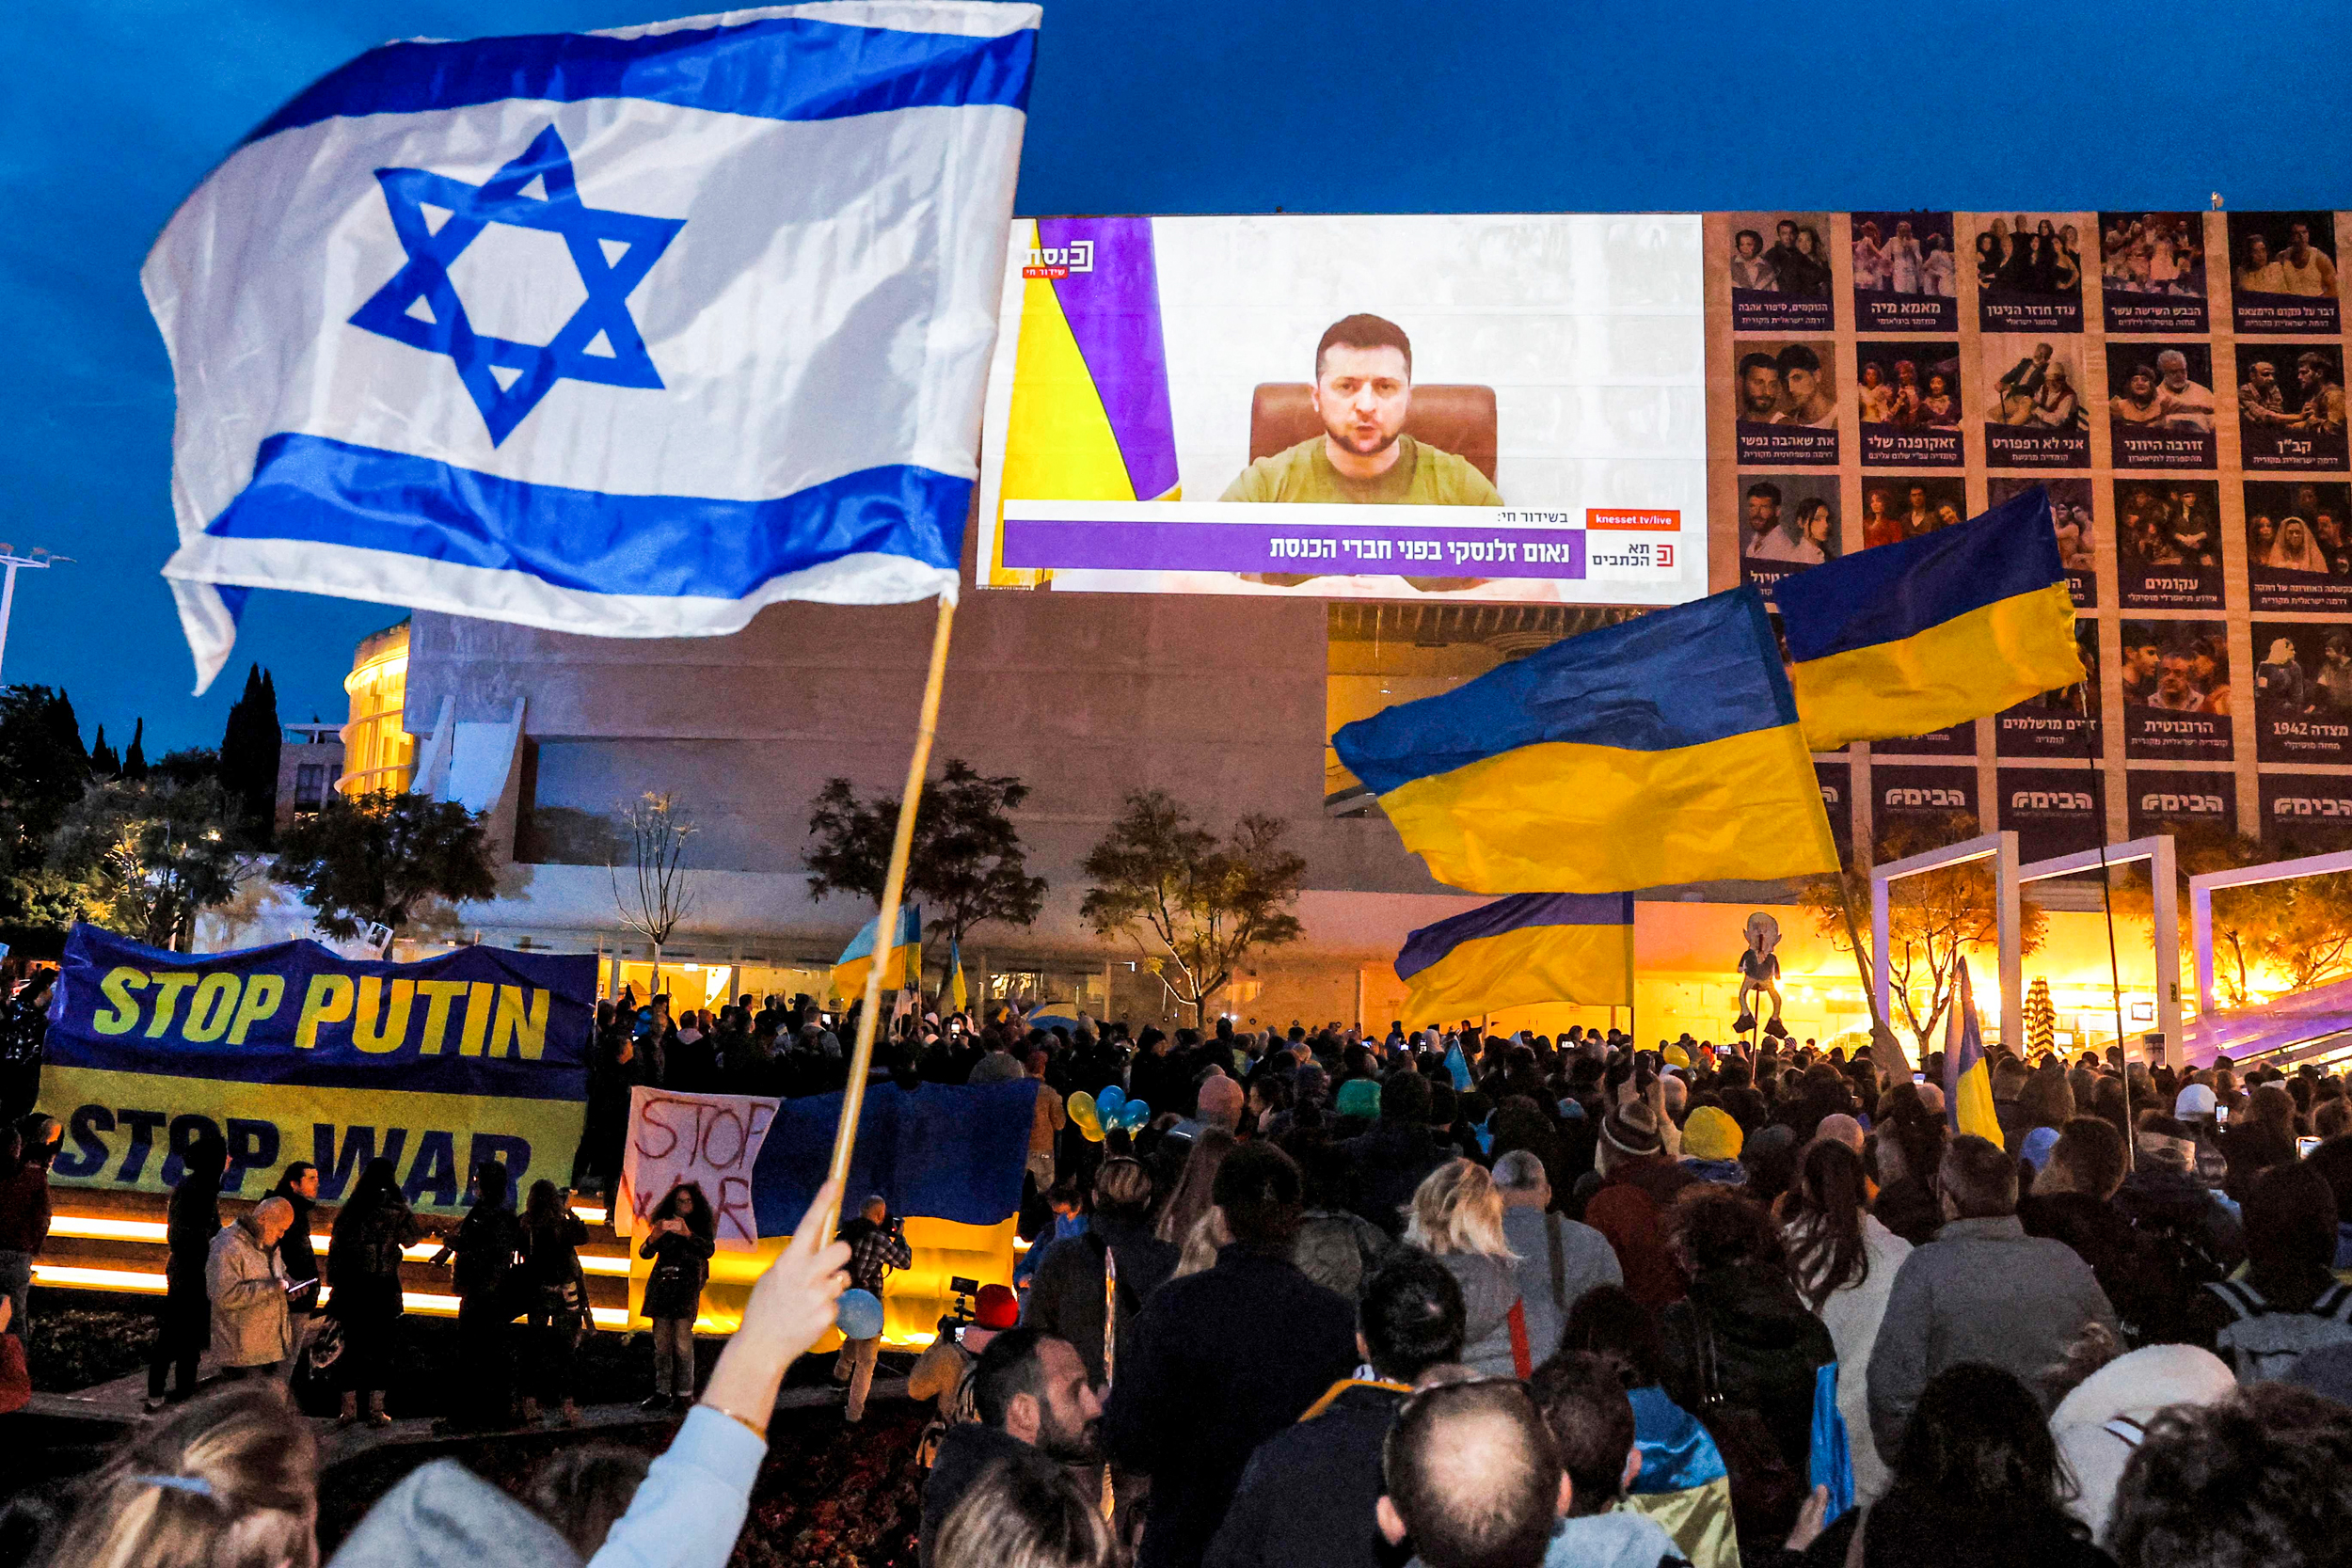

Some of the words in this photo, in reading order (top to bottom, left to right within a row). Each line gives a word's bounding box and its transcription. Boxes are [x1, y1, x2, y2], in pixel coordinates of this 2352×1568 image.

[1025, 268, 1036, 277] חי
[1039, 268, 1066, 277] שידור
[1738, 303, 1762, 311] אהבה
[1764, 303, 1788, 311] סיפור
[1870, 302, 1898, 314] מיה
[1900, 302, 1941, 314] מאמא
[1986, 305, 2022, 317] הניגון
[2025, 306, 2052, 315] חוזר
[2055, 306, 2076, 316] עוד
[2111, 307, 2133, 316] עשר
[2135, 307, 2170, 316] השישה
[2172, 307, 2201, 316] הכבש
[2237, 308, 2275, 316] הימצאם
[2277, 308, 2302, 318] מקום
[2303, 306, 2315, 316] על
[2317, 308, 2335, 316] דבר
[1740, 436, 1769, 447] נפשי
[1772, 436, 1814, 447] שאהבה
[1816, 436, 1836, 447] את
[1867, 435, 1894, 449] שלי
[1898, 437, 1956, 451] זאקופנה
[2042, 437, 2060, 450] לא
[2062, 438, 2084, 450] אני
[2123, 440, 2163, 451] היווני
[2166, 440, 2203, 451] זורבה
[1891, 451, 1911, 460] שלום
[1497, 512, 1516, 523] חי:
[1520, 512, 1568, 523] בשידור
[1596, 514, 1673, 526] knesset.tv/live
[1269, 537, 1337, 559] הכנסת
[1342, 539, 1392, 560] חברי
[1396, 540, 1443, 561] בפני
[1446, 537, 1518, 565] זלנסקי
[1522, 543, 1570, 563] נאום
[1629, 543, 1650, 555] תא
[1592, 554, 1650, 567] הכתבים
[2145, 578, 2199, 593] עקומים
[2277, 583, 2288, 592] של
[2003, 716, 2062, 730] מושלמים
[2066, 719, 2097, 731] זים
[2144, 721, 2214, 734] הרובוטית
[2273, 721, 2308, 736] 1942
[2311, 724, 2349, 736] מצדה
[92, 965, 285, 1046] STOP
[294, 973, 550, 1061] PUTIN
[634, 1097, 776, 1171] STOP
[51, 1103, 280, 1193] STOP
[621, 1173, 754, 1245] WR
